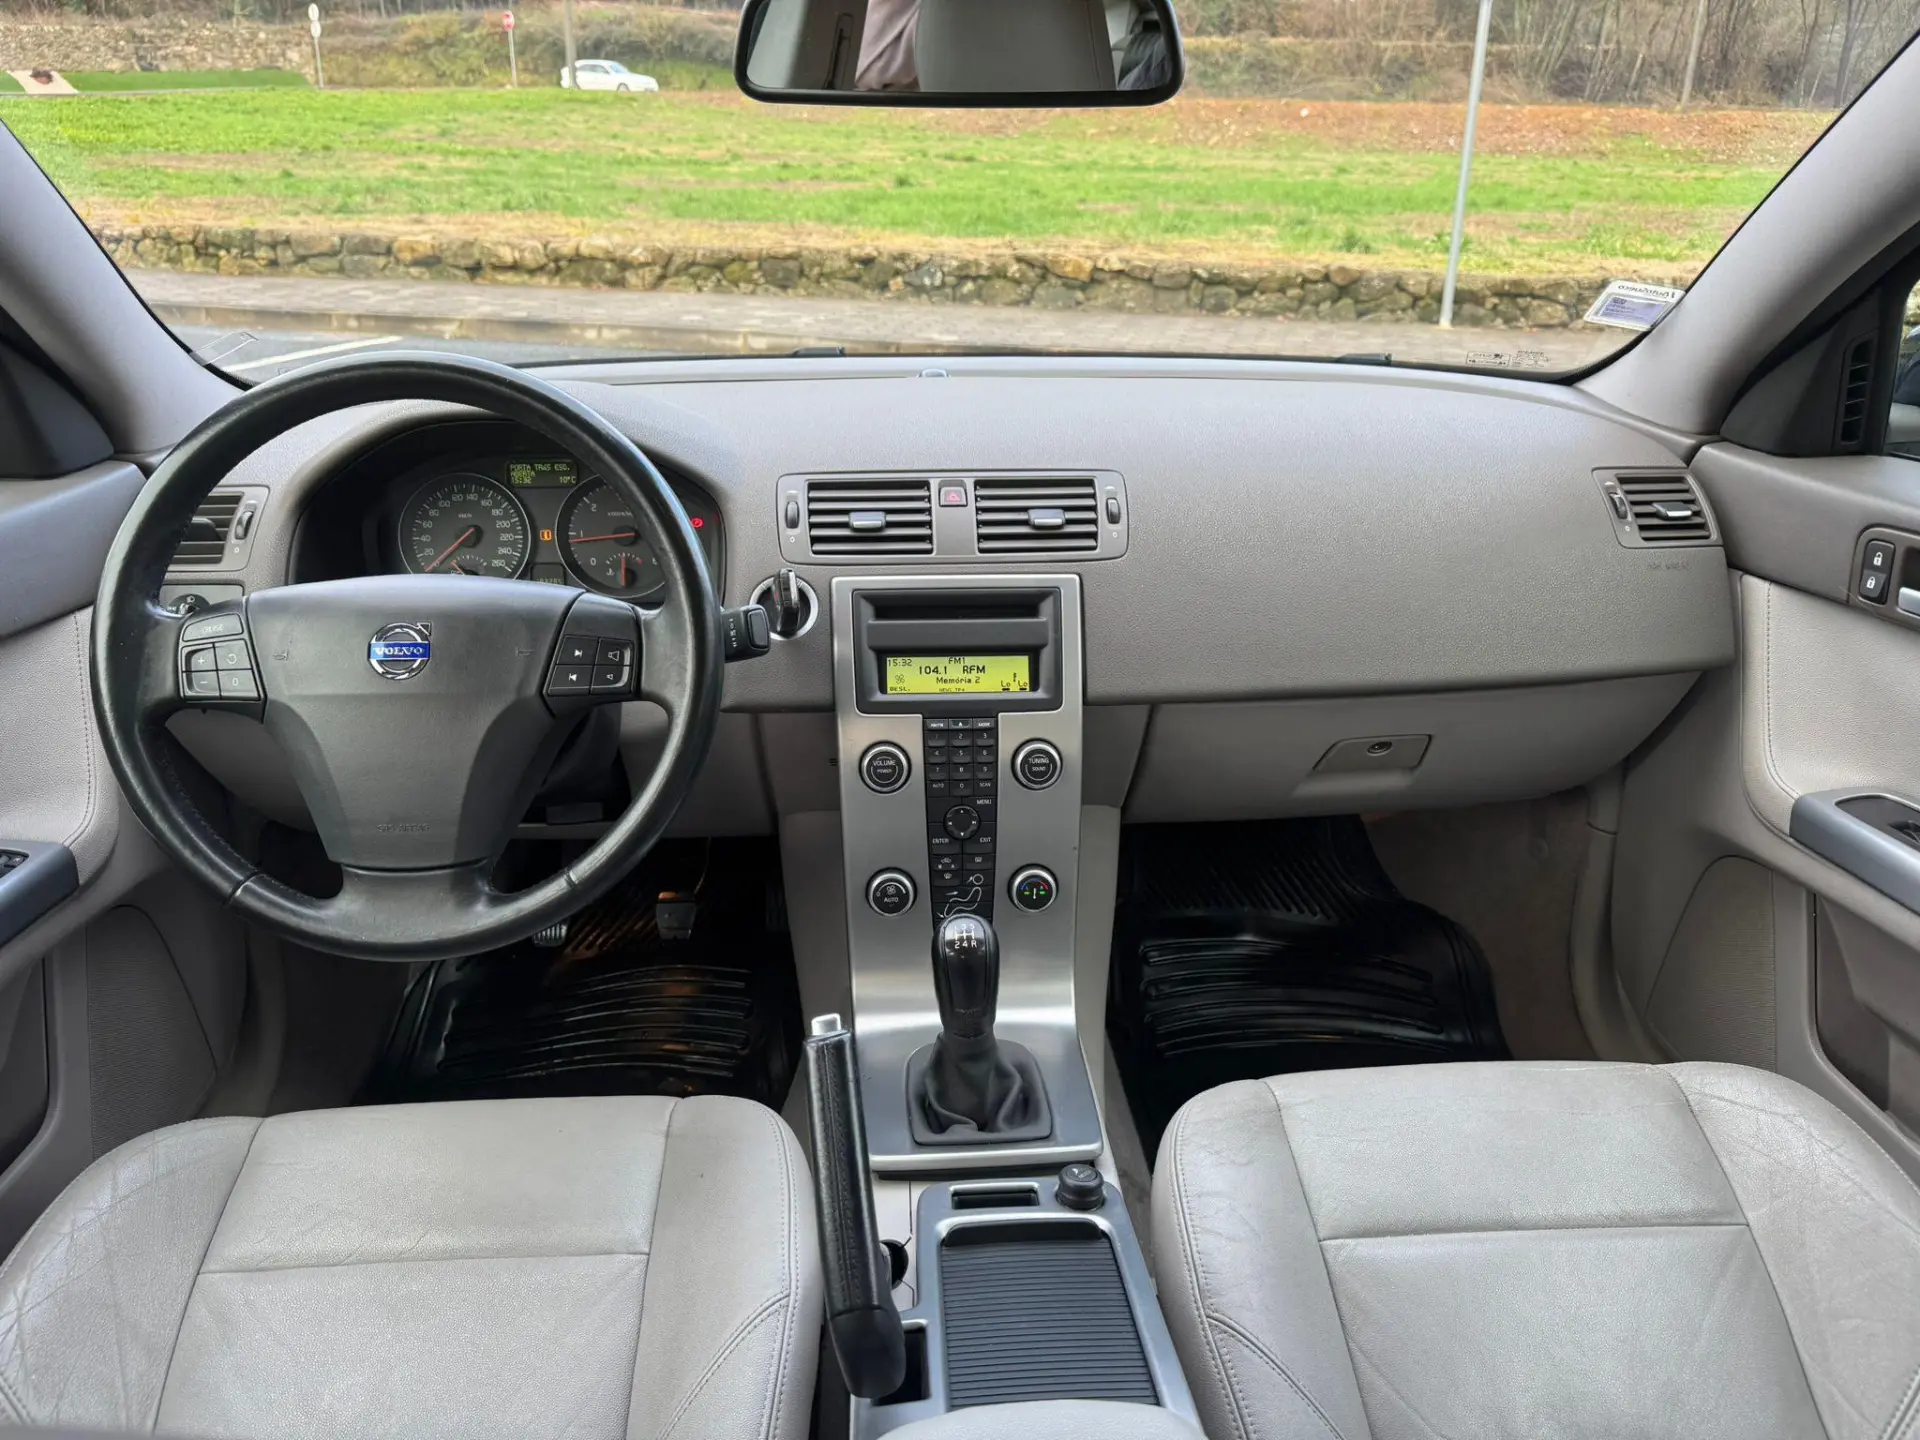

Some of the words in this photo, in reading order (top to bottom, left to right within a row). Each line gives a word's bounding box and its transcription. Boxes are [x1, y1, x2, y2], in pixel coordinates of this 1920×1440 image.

[466, 493, 478, 501] 140
[481, 499, 492, 507] 160
[496, 520, 510, 528] 200
[500, 533, 514, 541] 220
[492, 559, 505, 567] 260
[373, 646, 423, 655] VOLVO
[888, 658, 912, 667] 15:32
[919, 666, 947, 675] 104.1
[962, 665, 986, 674] RFM
[936, 676, 972, 684] Memória
[975, 676, 980, 684] 2
[954, 941, 960, 949] 2
[971, 940, 977, 948] R
